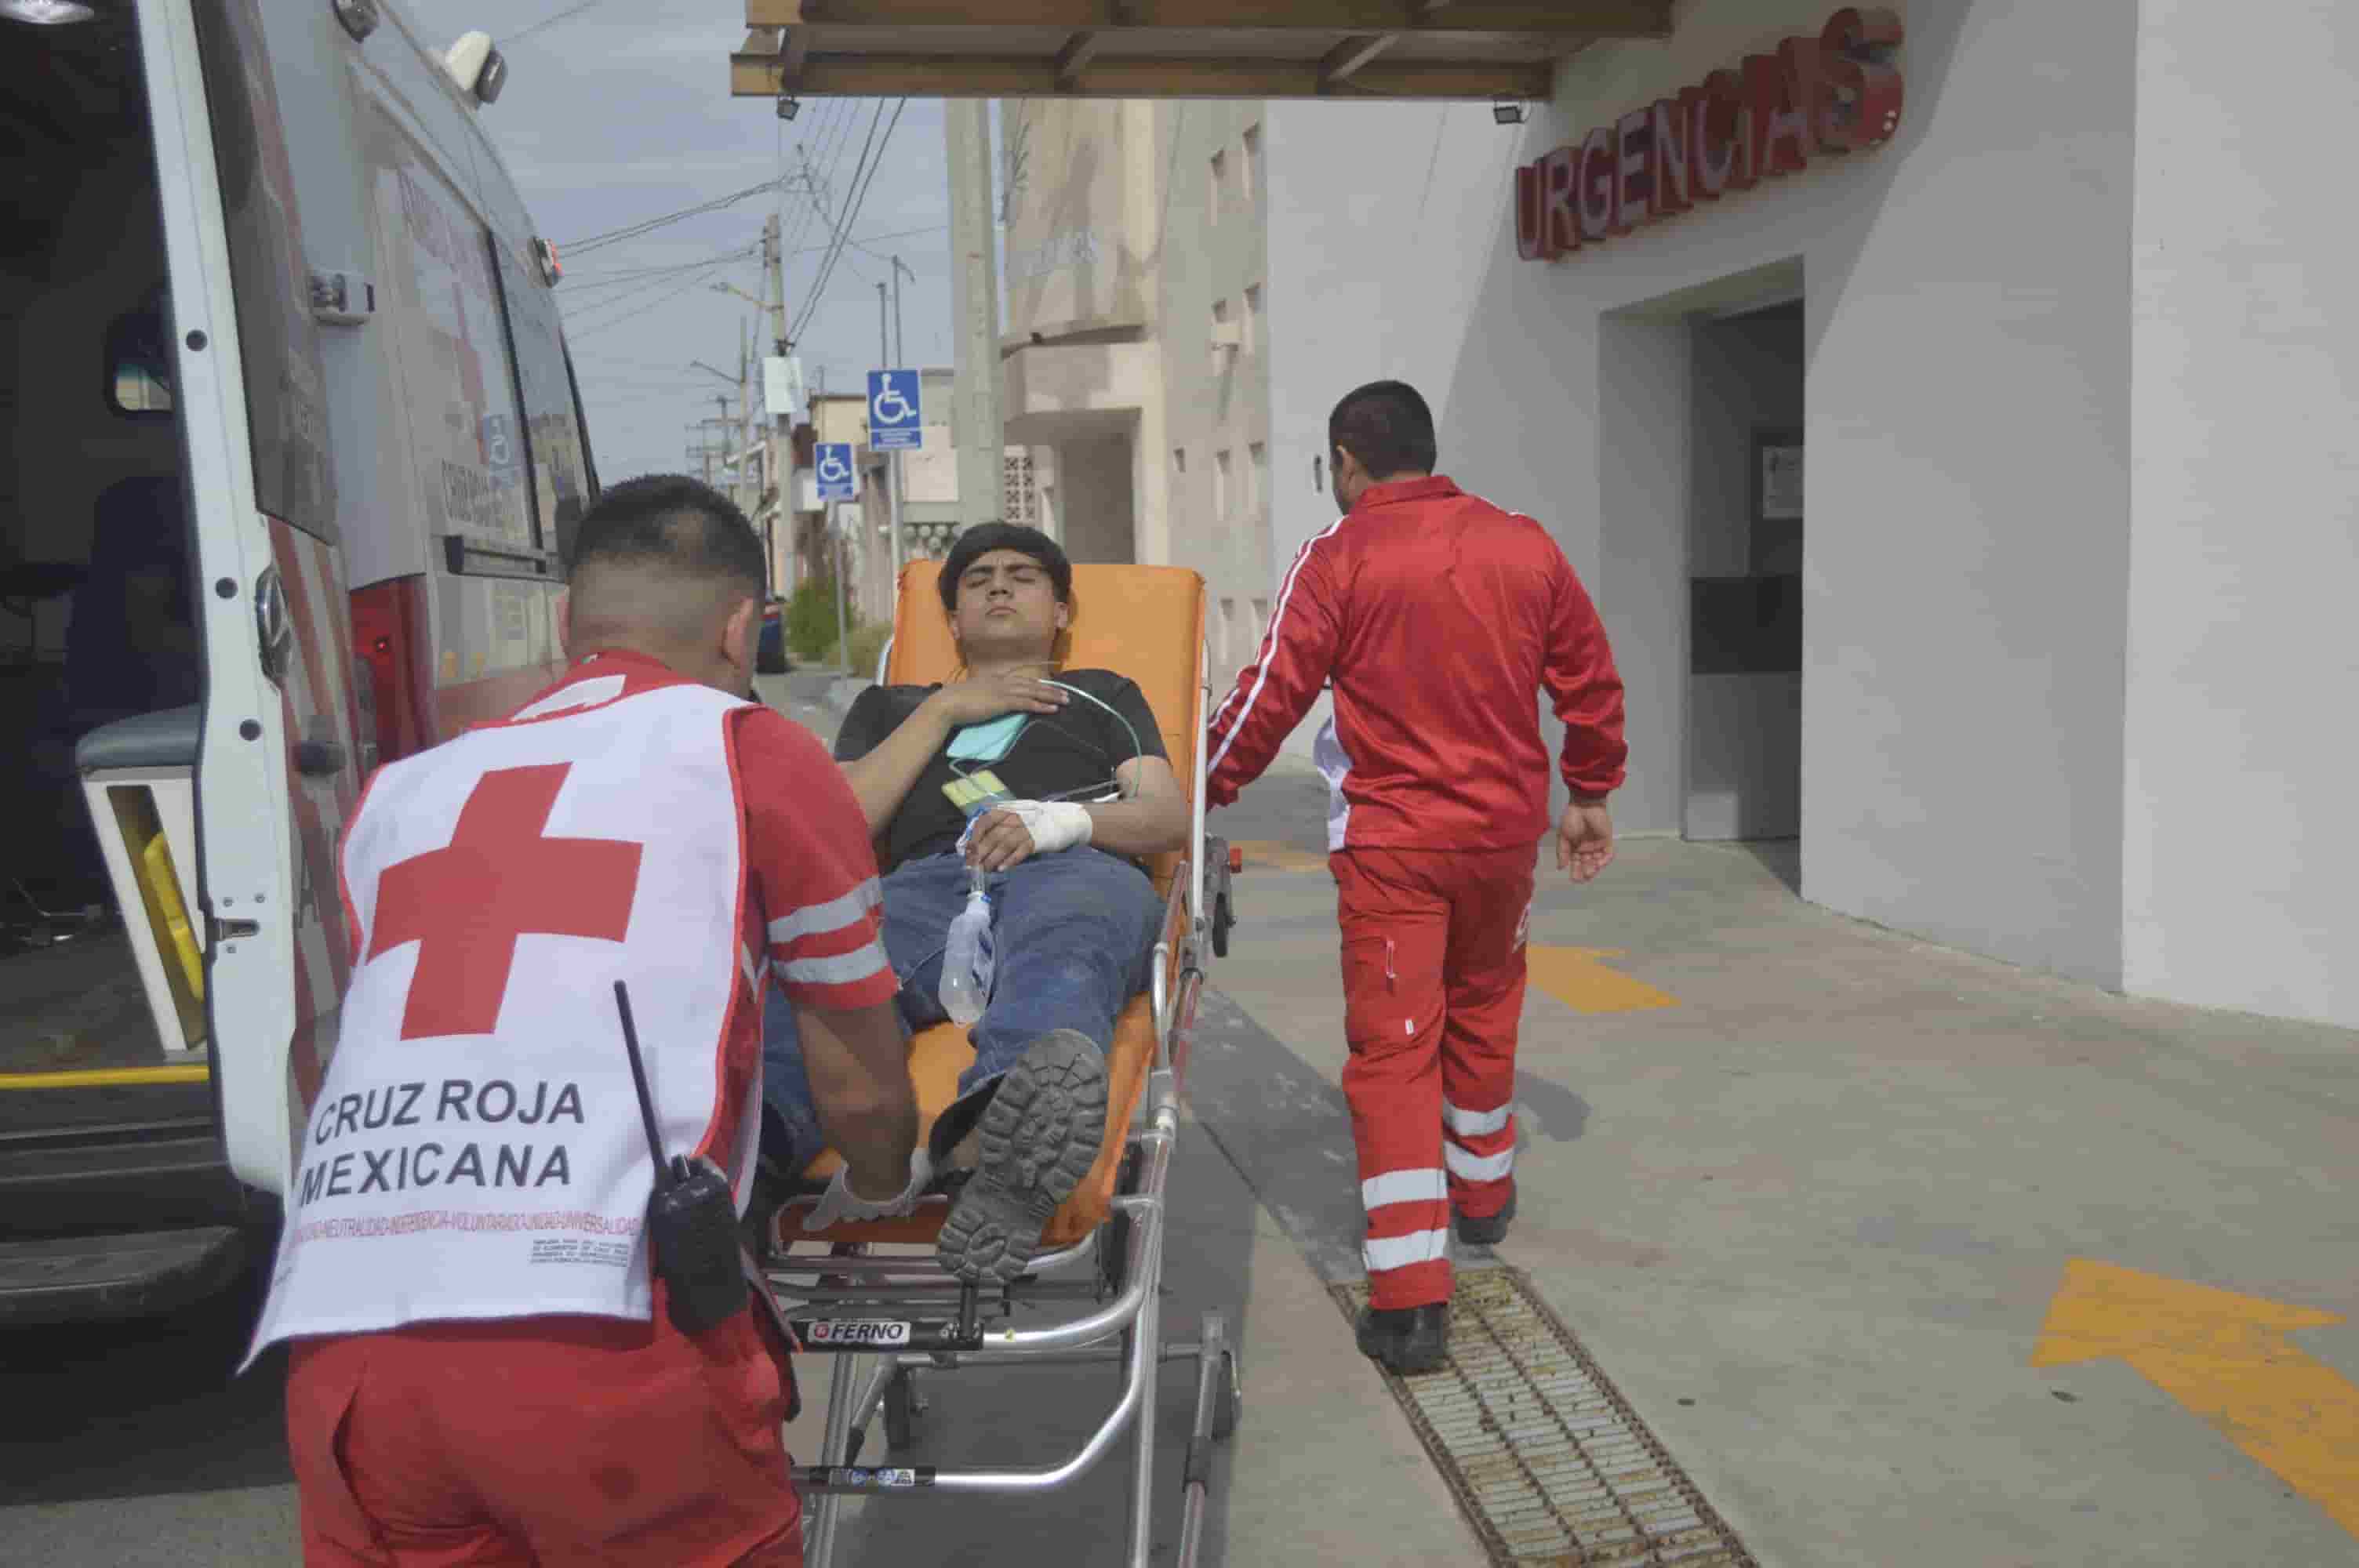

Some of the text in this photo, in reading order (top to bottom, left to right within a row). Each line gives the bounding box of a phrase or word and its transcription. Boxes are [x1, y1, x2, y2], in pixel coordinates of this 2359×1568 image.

[1516, 7, 1903, 262] URGENCIAS
[315, 1079, 584, 1145] CRUZ ROJA
[300, 1142, 571, 1207] MEXICANA
[831, 1322, 904, 1339] FERNO
